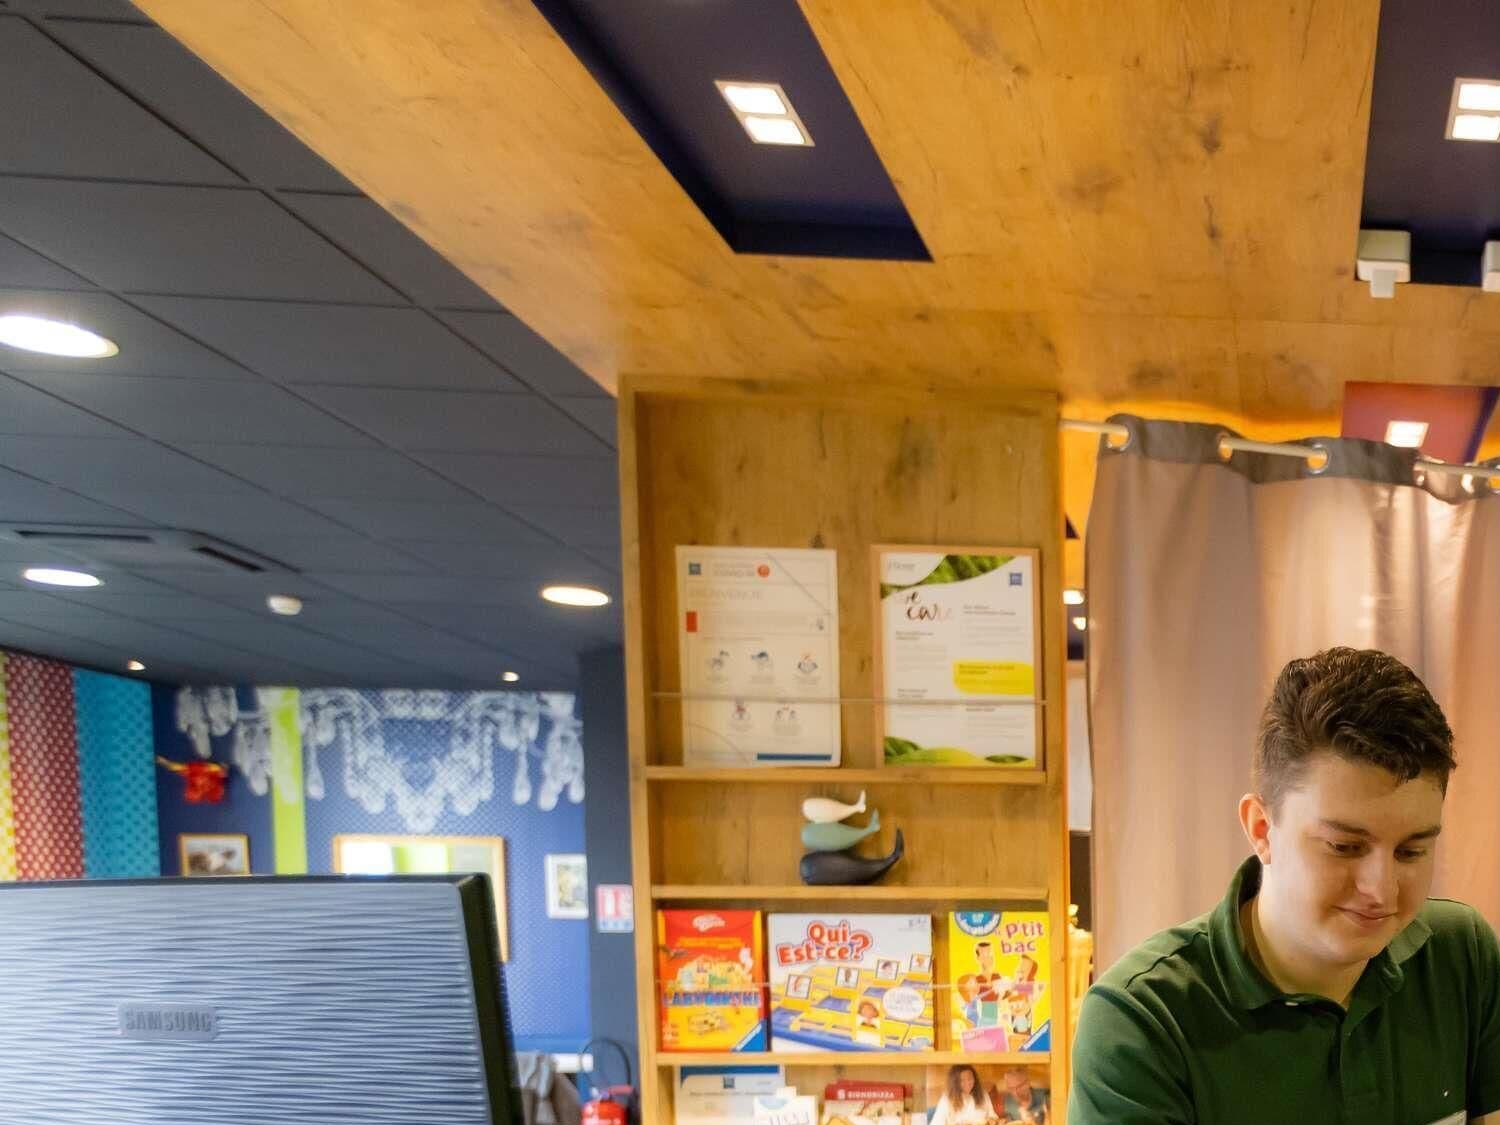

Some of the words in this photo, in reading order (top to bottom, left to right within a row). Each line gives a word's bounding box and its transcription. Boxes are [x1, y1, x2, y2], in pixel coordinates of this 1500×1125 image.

[808, 922, 849, 945] Qui
[1001, 939, 1036, 954] bac
[125, 1010, 213, 1032] SAMSUNG
